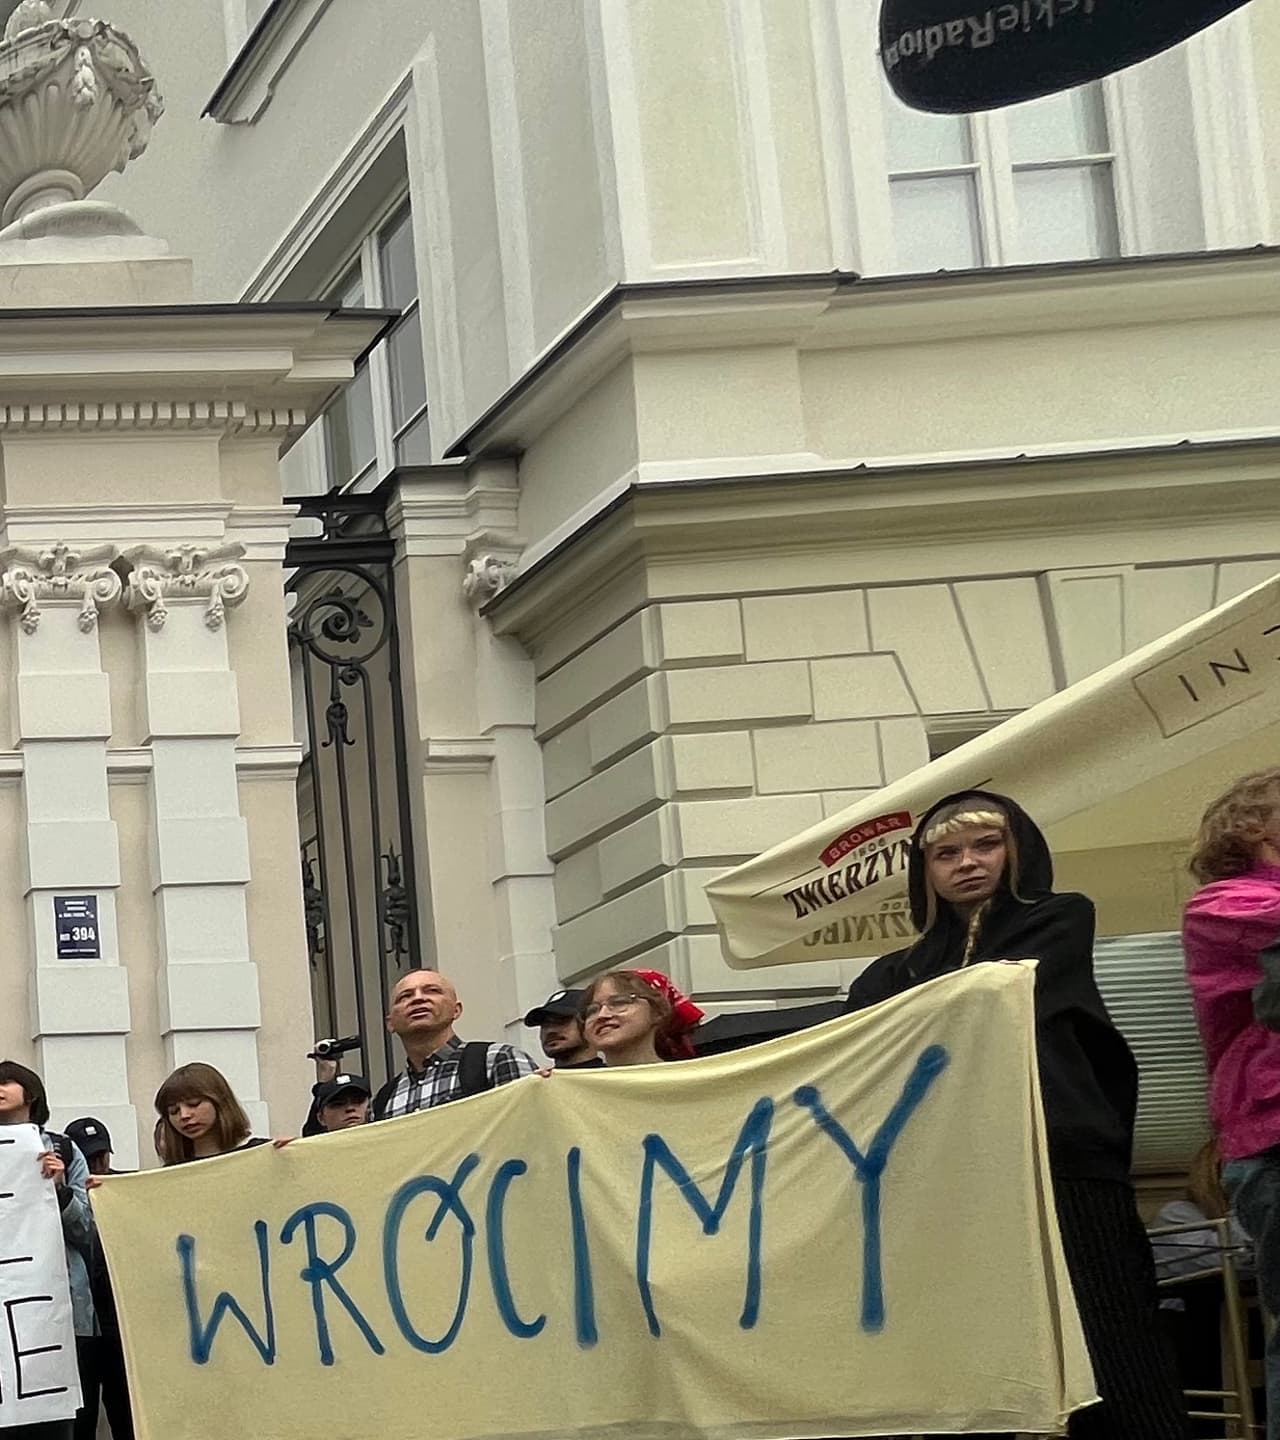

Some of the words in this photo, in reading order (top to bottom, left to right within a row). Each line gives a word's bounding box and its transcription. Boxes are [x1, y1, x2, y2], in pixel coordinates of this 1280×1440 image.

[828, 816, 902, 860] BROWAR
[782, 838, 913, 920] ZWIERZYN
[72, 926, 96, 941] 394
[174, 1043, 950, 1368] WRÓCIMY
